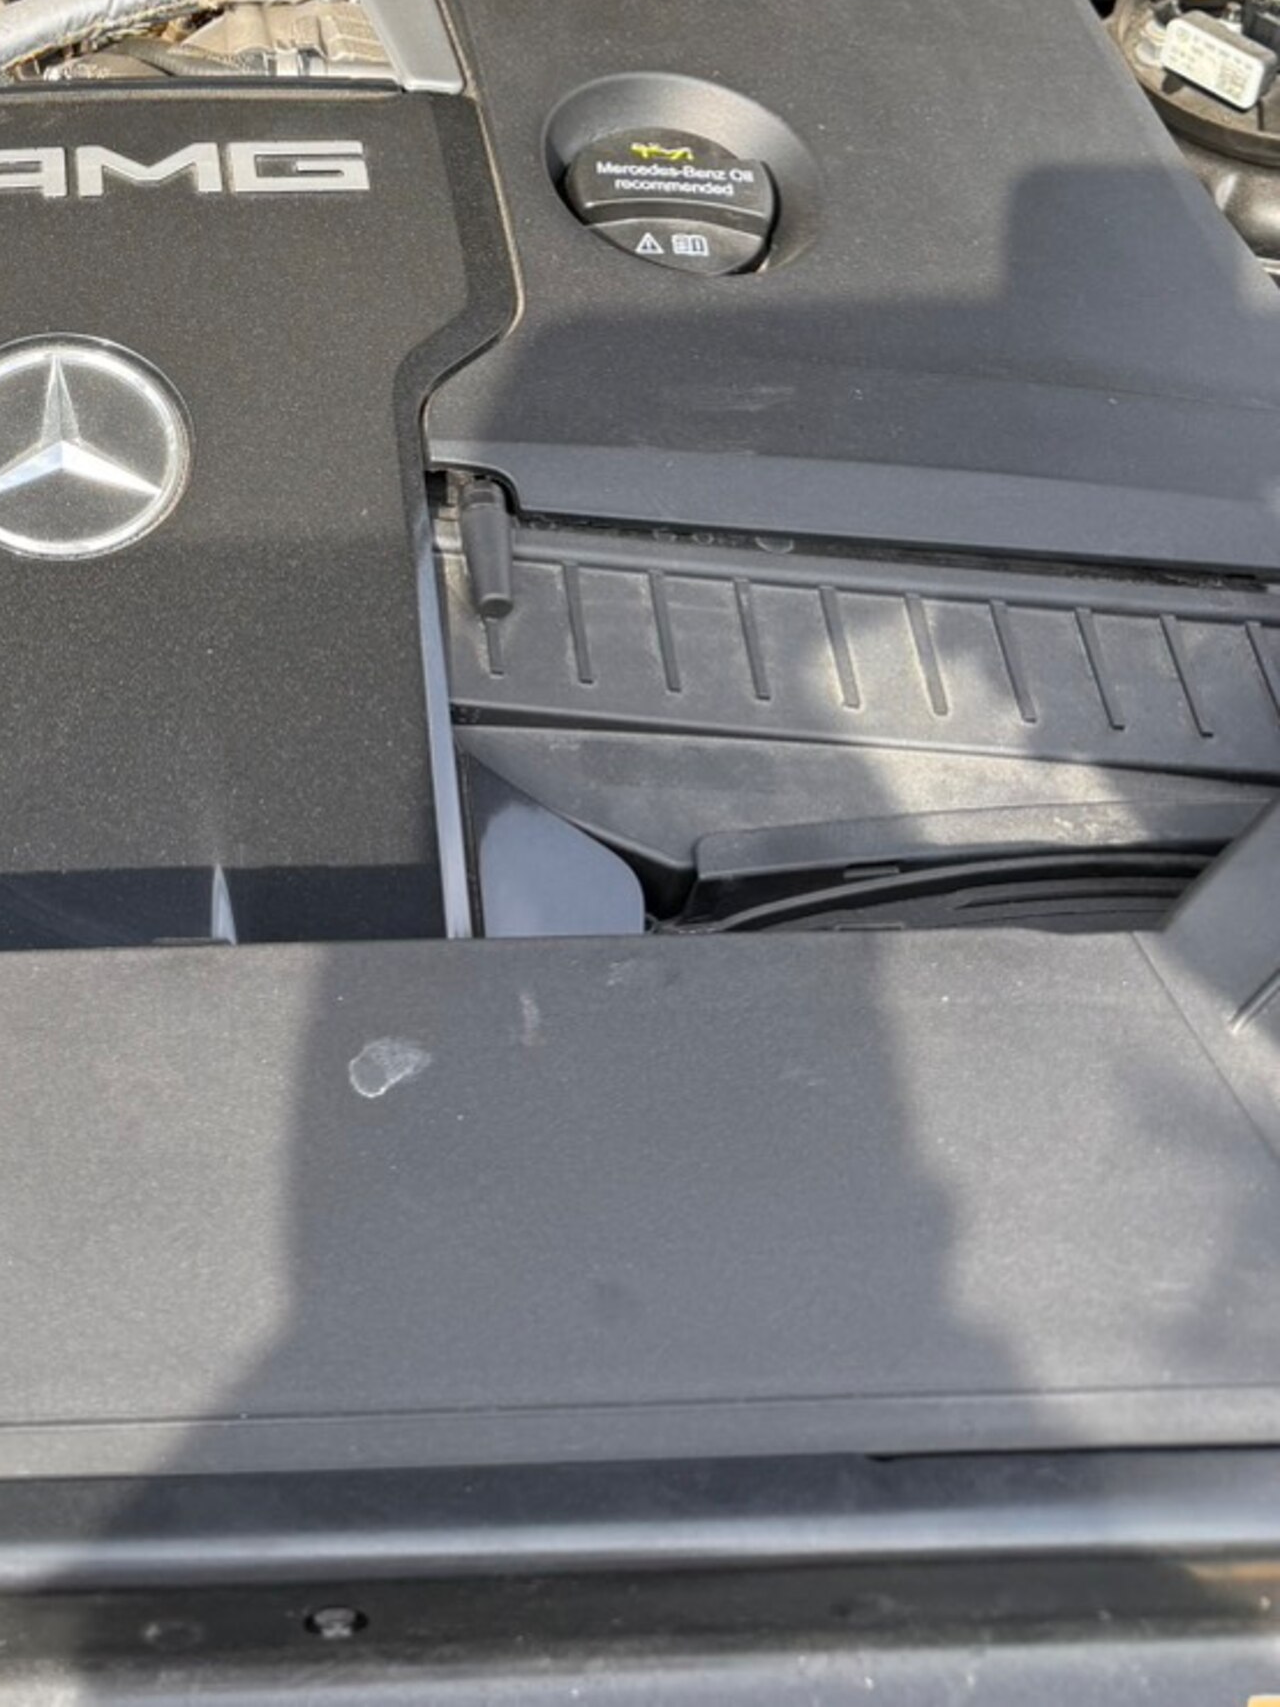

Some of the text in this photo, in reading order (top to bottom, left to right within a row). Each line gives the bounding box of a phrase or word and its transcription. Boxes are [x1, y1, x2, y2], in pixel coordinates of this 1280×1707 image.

[596, 160, 755, 184] Mercedes-Benz Oil
[614, 177, 734, 197] recommended
